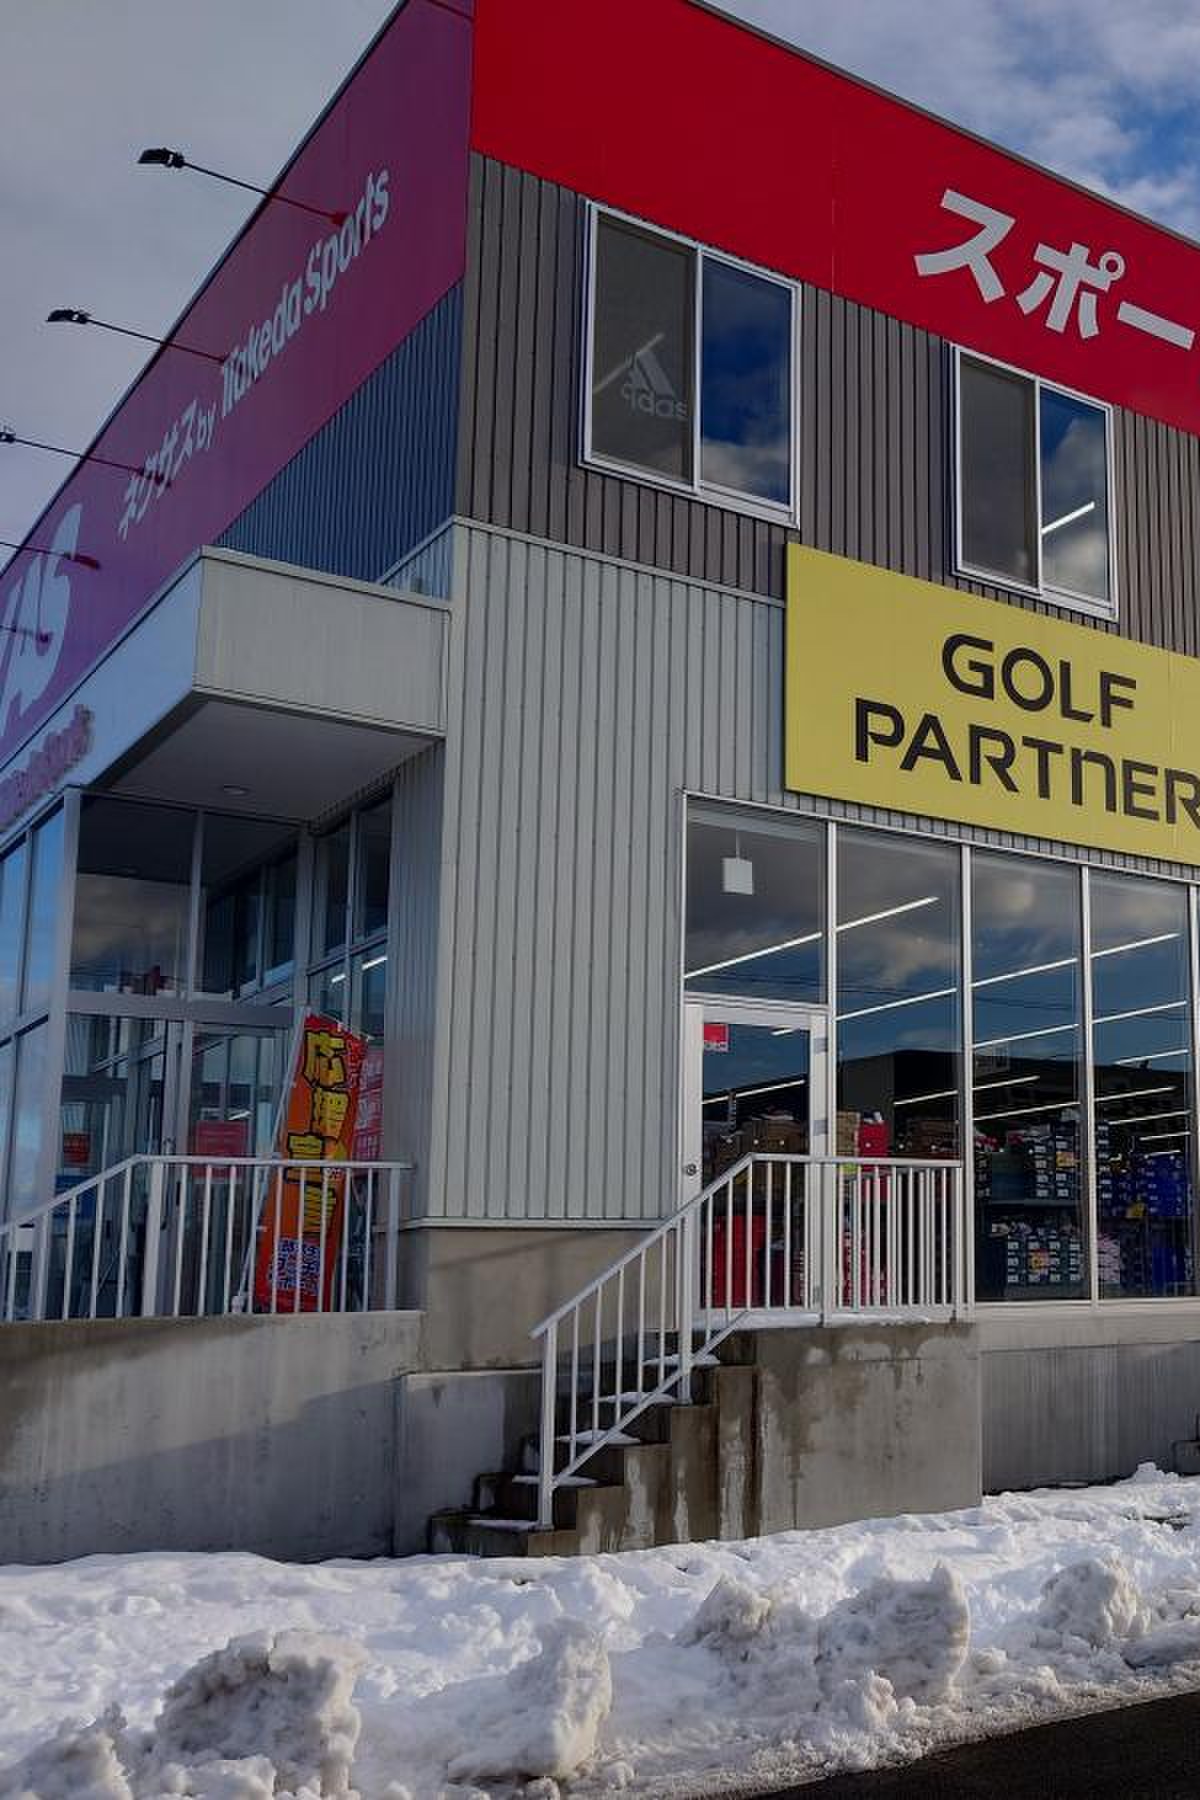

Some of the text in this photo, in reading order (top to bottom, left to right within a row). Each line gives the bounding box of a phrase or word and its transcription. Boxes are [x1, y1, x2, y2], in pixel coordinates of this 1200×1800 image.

[200, 402, 217, 451] by
[223, 276, 303, 417] Takeda
[305, 169, 389, 314] Sports
[942, 633, 1137, 729] GOLF
